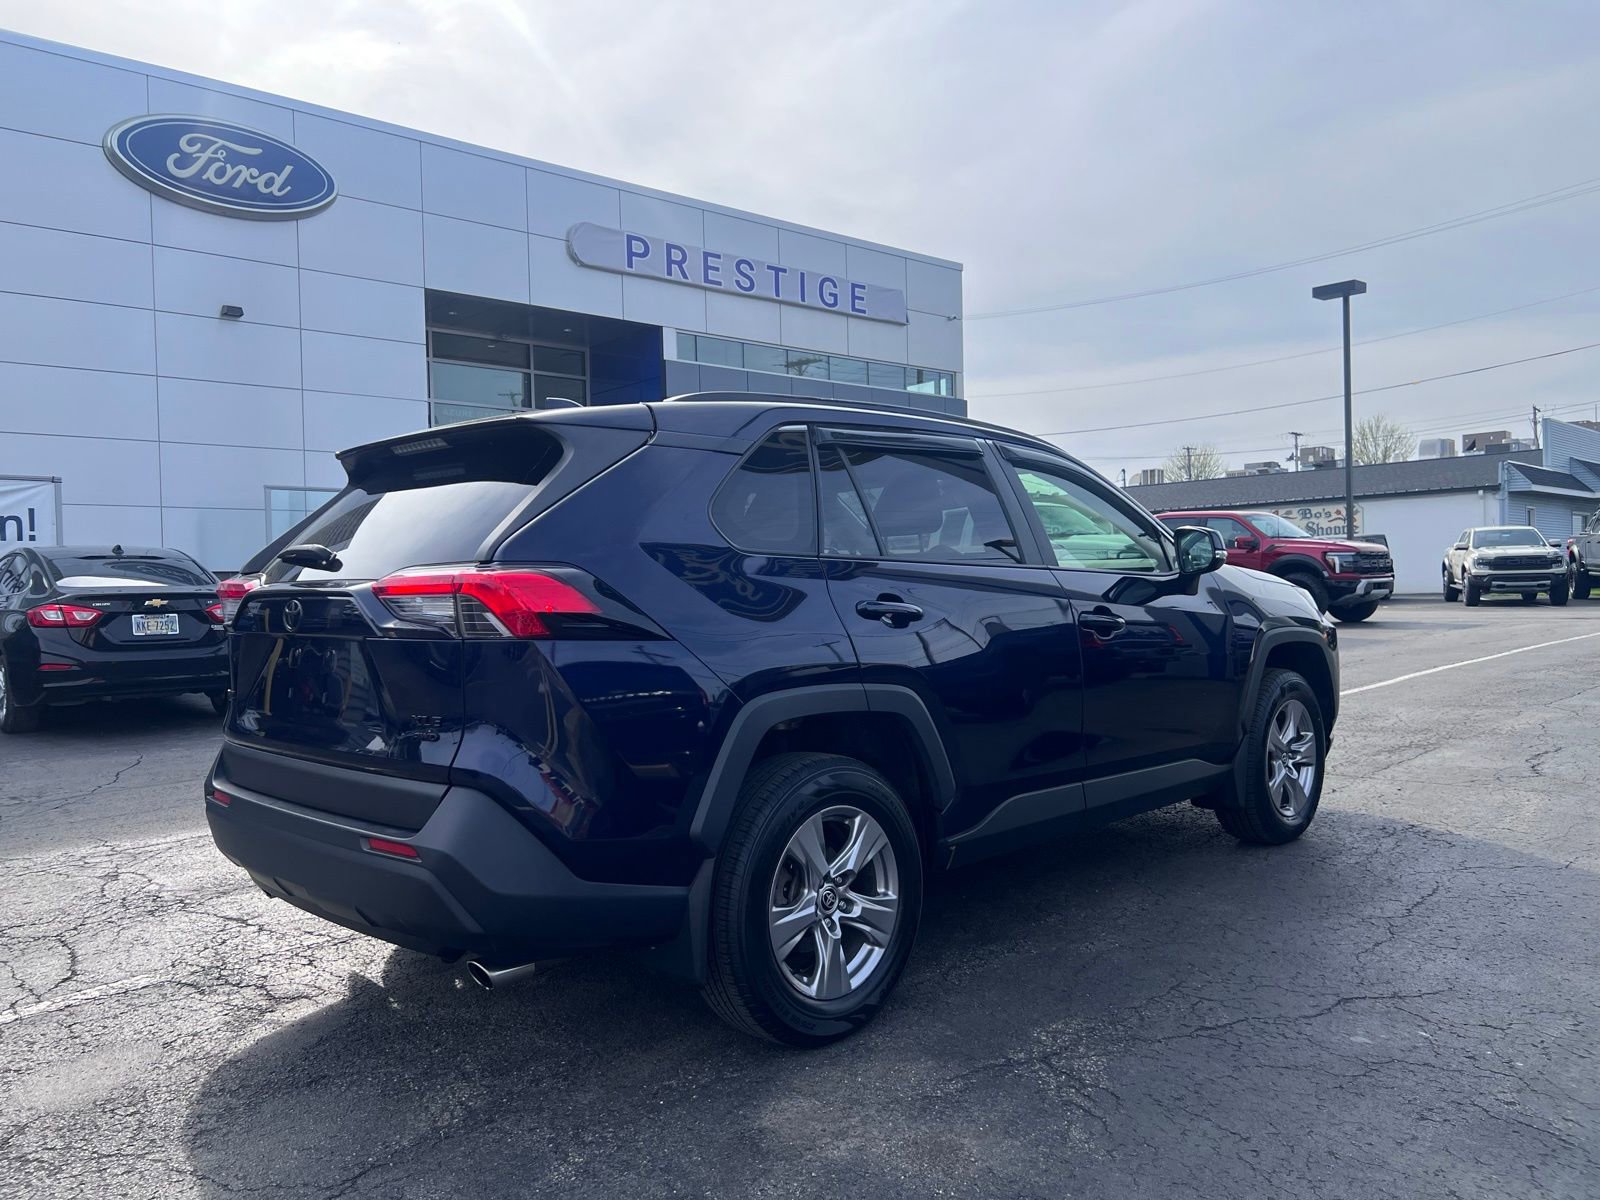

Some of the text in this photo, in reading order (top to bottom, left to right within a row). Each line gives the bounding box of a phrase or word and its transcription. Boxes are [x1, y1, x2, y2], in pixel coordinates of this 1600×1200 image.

[166, 133, 294, 197] Ford
[625, 233, 867, 314] PRESTIGE
[1297, 508, 1332, 521] Bo's
[155, 621, 175, 632] 7252
